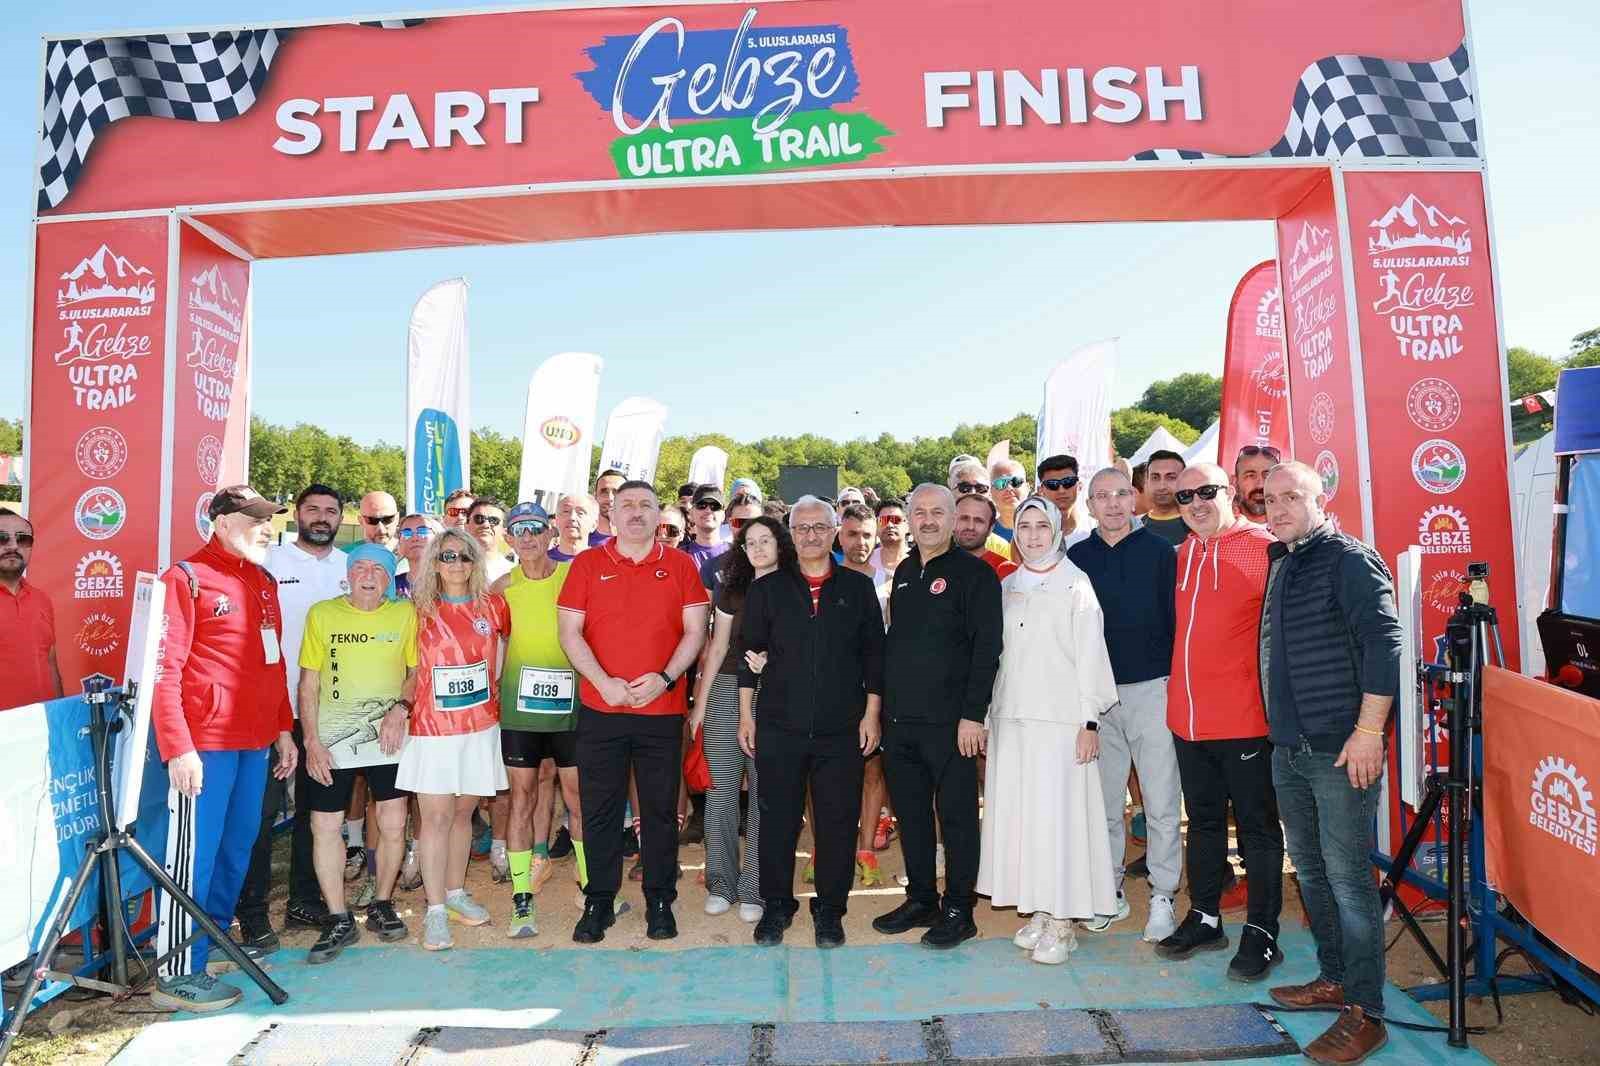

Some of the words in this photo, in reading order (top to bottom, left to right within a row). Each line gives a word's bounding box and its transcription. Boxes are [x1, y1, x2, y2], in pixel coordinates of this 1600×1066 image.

[748, 38, 757, 48] 5.
[760, 33, 836, 48] ULUSLARARASI
[612, 8, 846, 134] Gebze
[924, 66, 1202, 127] FINISH
[273, 88, 540, 155] START
[627, 134, 741, 176] ULTRA
[753, 122, 862, 163] TRAIL
[1403, 272, 1475, 311] Gebze
[1391, 314, 1464, 337] ULTRA
[83, 322, 152, 360] Gebze
[1301, 326, 1332, 360] ULTRA
[1396, 335, 1464, 361] TRAIL
[69, 363, 138, 387] ULTRA
[1304, 345, 1334, 380] TRAIL
[73, 384, 137, 410] TRAIL
[194, 370, 232, 400] ULTRA
[1418, 531, 1472, 546] GEBZE
[74, 576, 124, 590] GEBZE
[448, 679, 475, 694] 8138
[532, 683, 559, 697] 8139
[1531, 791, 1598, 842] GEBZE
